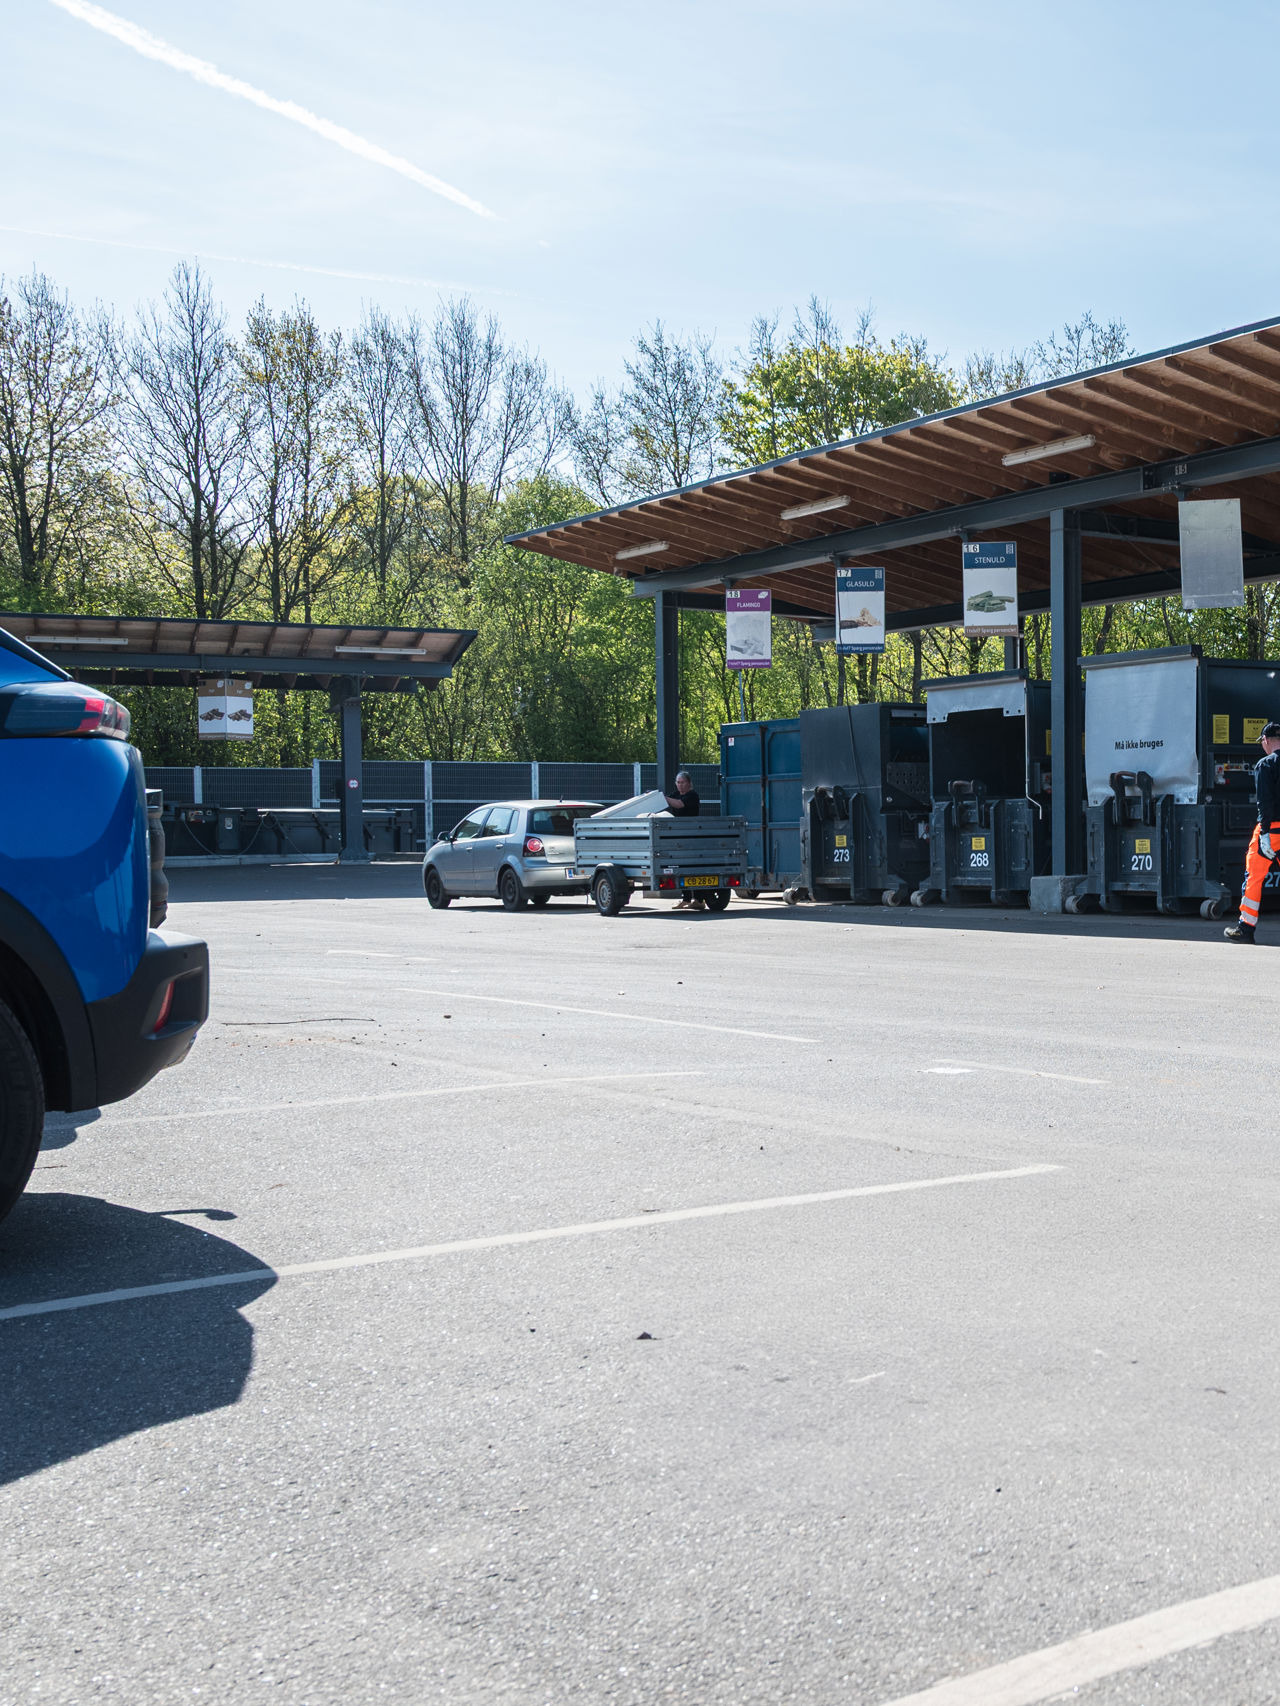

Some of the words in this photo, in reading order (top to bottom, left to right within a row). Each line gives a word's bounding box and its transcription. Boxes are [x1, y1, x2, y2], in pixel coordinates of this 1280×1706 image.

[974, 556, 1006, 564] STENULD
[846, 580, 875, 588] GLASULD
[1115, 740, 1125, 750] Må
[1125, 740, 1139, 750] ikke
[1139, 739, 1164, 750] bruges
[833, 848, 850, 862] 273
[970, 852, 989, 867] 268
[1131, 855, 1153, 871] 270
